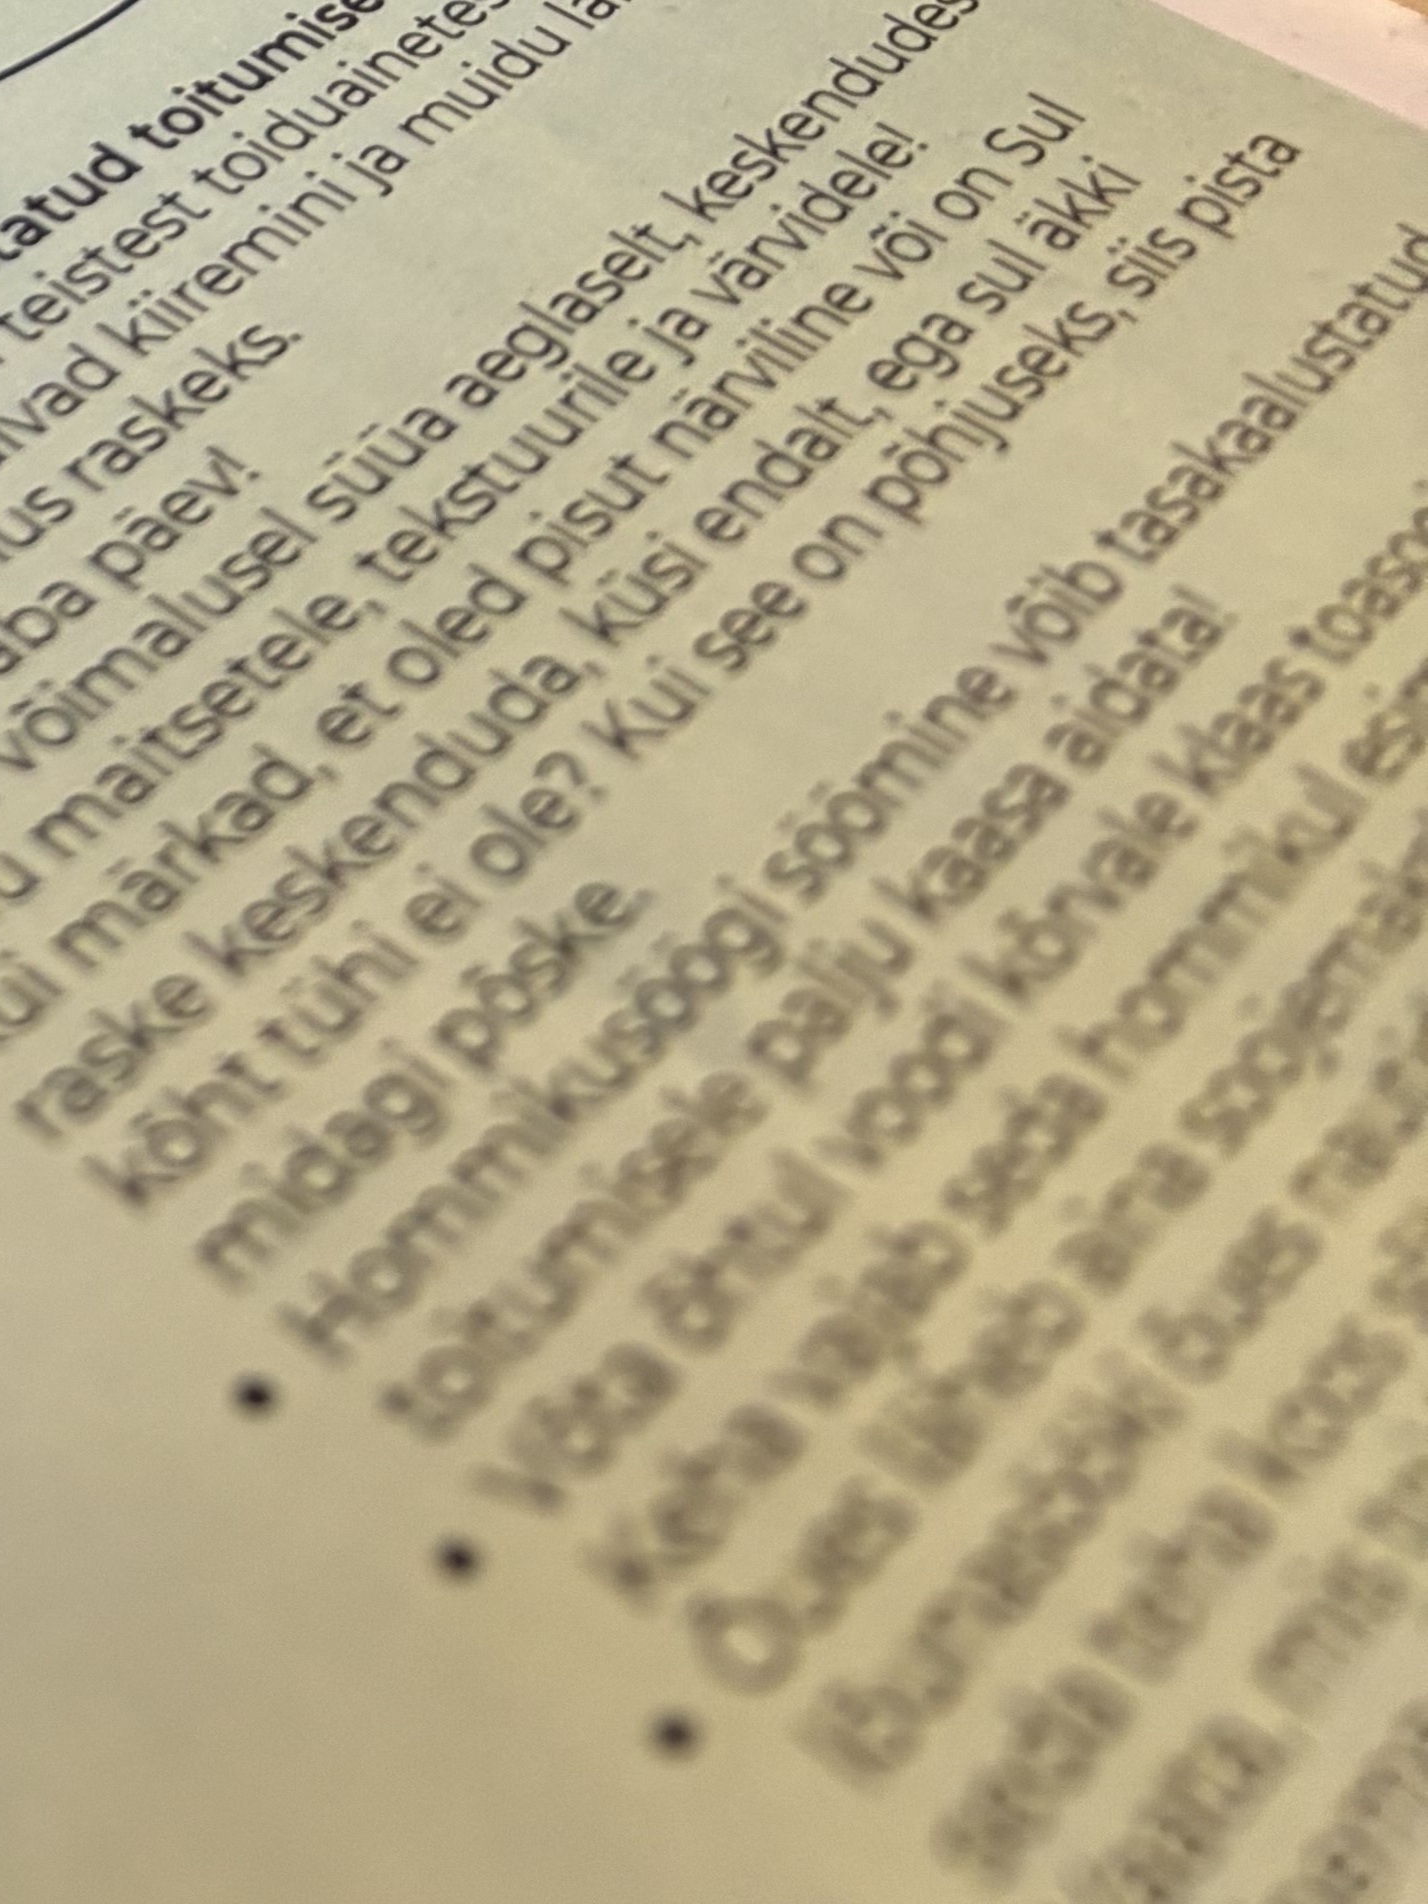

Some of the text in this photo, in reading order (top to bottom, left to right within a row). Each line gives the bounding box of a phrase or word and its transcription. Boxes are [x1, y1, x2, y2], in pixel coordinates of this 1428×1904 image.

[96, 171, 357, 358] kiiremini
[331, 136, 410, 197] ja
[399, 23, 572, 146] muidu
[305, 400, 458, 523] süüa
[444, 220, 696, 411] aeglaselt,
[30, 590, 388, 861] maitsetele,
[353, 340, 655, 586] tekstuurile
[625, 303, 711, 366] ja
[690, 123, 928, 311] värvidele!
[51, 743, 338, 970] märkad,
[317, 676, 400, 750] et
[387, 565, 526, 694] oled
[515, 437, 670, 588] pisut
[651, 276, 875, 460] närviline
[853, 210, 950, 287] või
[932, 165, 1015, 222] on
[983, 91, 1087, 167] Sul
[61, 322, 302, 492] raskeks.
[86, 445, 263, 588] päev!
[15, 154, 1143, 1143] raske keskenduda, küsi endalt, ega sul äkki
[83, 132, 1304, 1216] kõht tühi ei ole? Kui see on põhjuseks, siis pista
[762, 664, 1018, 901] söömine
[990, 559, 1123, 667] võib
[195, 881, 653, 1291] midagi põske.
